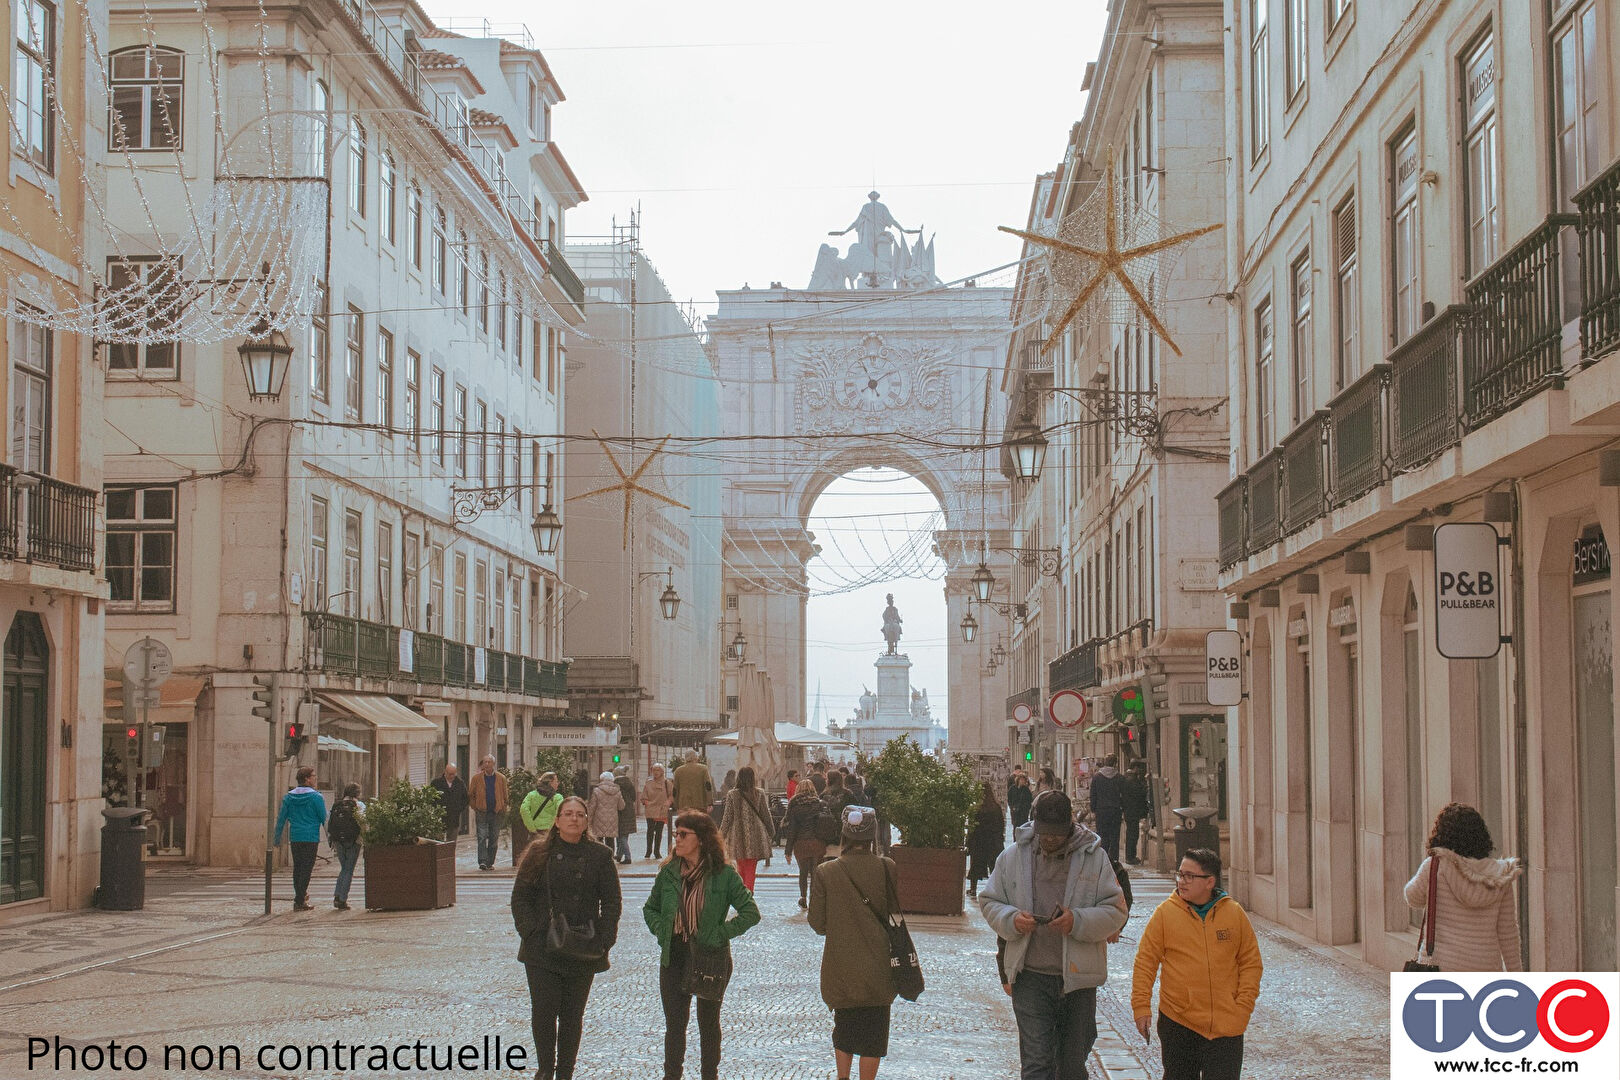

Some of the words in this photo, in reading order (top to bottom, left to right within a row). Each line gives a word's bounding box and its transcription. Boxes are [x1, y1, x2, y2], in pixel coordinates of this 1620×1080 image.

[1440, 571, 1495, 596] P&B
[1440, 599, 1496, 609] PULL&BEAR
[1208, 657, 1240, 671] P&B
